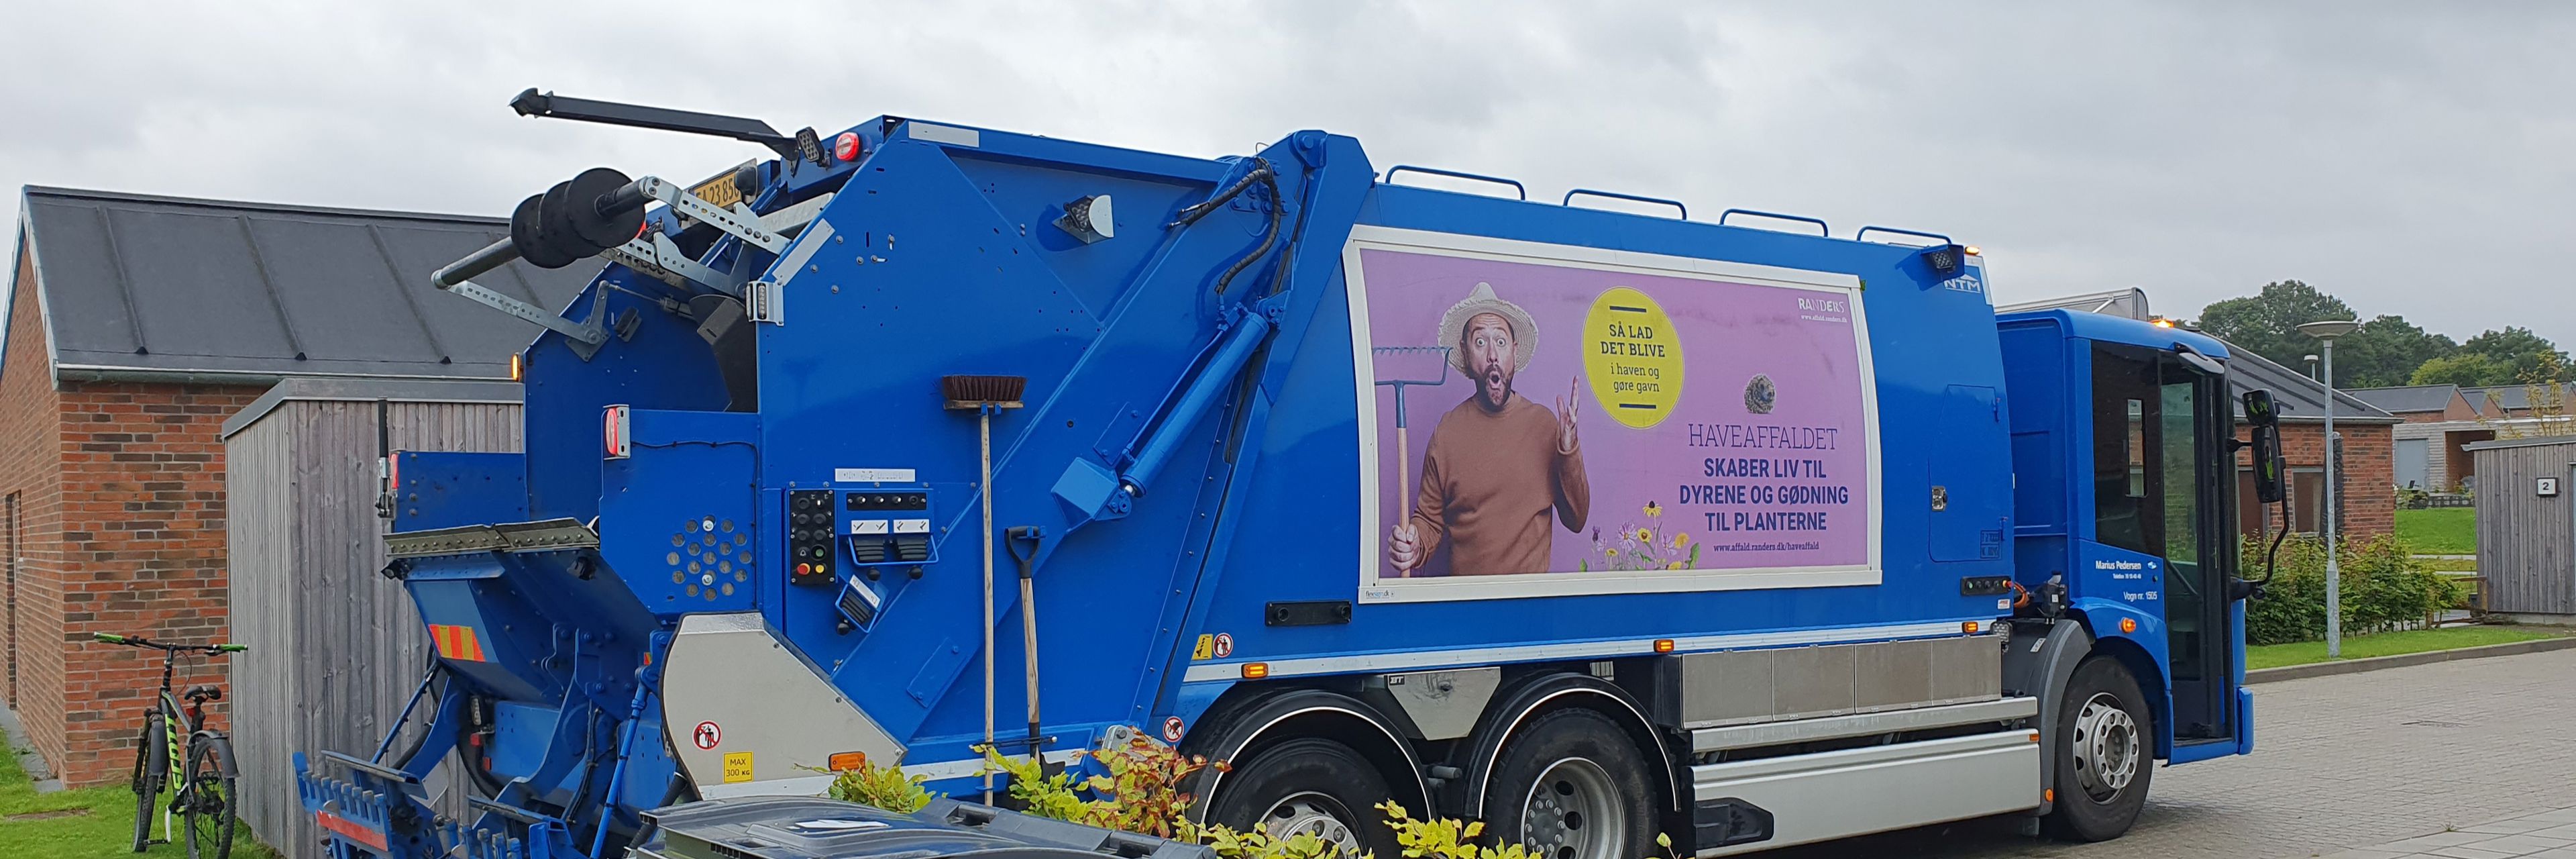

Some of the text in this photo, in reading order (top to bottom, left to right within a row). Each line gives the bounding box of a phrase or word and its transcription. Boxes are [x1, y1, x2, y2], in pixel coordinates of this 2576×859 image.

[709, 184, 720, 206] 23
[1943, 279, 1981, 291] NTM
[1798, 297, 1844, 313] RANDERS
[1609, 321, 1653, 339] SÅ LAD
[1601, 341, 1666, 358] DET BLIVE
[1611, 362, 1660, 380] i haven og
[1613, 381, 1660, 394] gøre gavn
[1688, 423, 1838, 450] HAVEAFFALDET
[1704, 458, 1827, 478] SKABER LIV TIL
[2542, 482, 2549, 491] 2
[1680, 485, 1849, 505] DYRENE OG GØDNING
[1705, 512, 1827, 531] TIL PLANTERNE
[1713, 542, 1819, 552] www.affald.randers.dk/haveaffald
[2096, 560, 2141, 570] Marius Pedersen
[2123, 591, 2137, 602] Vogn
[2145, 591, 2157, 601] 1505
[165, 713, 183, 790] SCOTT
[730, 758, 746, 766] MAX
[726, 768, 740, 777] 300
